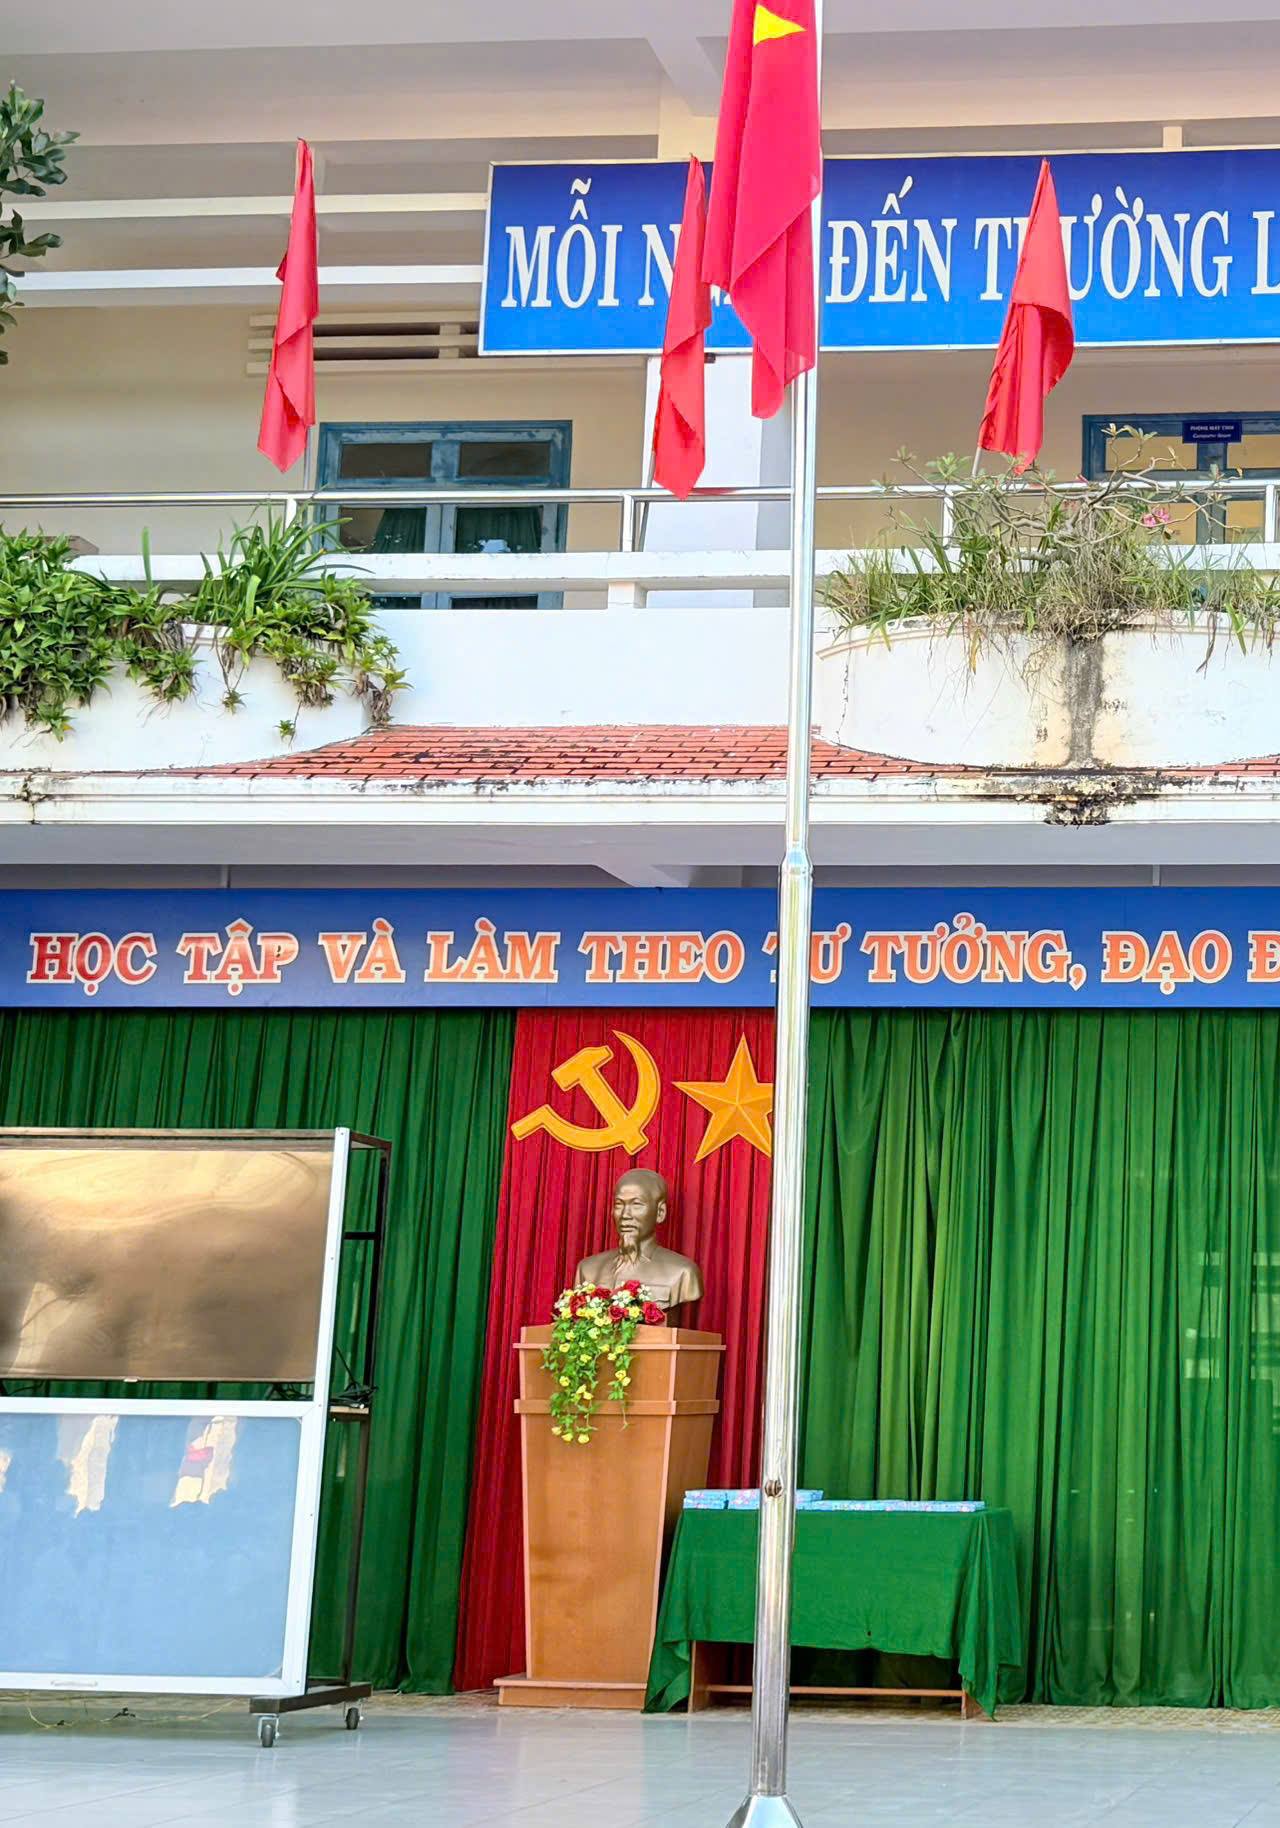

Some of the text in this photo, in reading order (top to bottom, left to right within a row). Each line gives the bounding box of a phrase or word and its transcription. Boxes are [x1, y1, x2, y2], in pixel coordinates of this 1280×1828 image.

[501, 178, 623, 309] MỖI
[825, 176, 957, 304] ĐẾN
[974, 185, 1233, 301] TƯỜNG
[26, 931, 157, 996] HỌC
[176, 917, 299, 996] TẬP
[318, 917, 406, 984] VÀ
[424, 917, 560, 984] LÀM
[578, 931, 745, 984] THEO
[860, 912, 1087, 991] TƯỞNG,
[1102, 930, 1232, 995] ĐẠO
